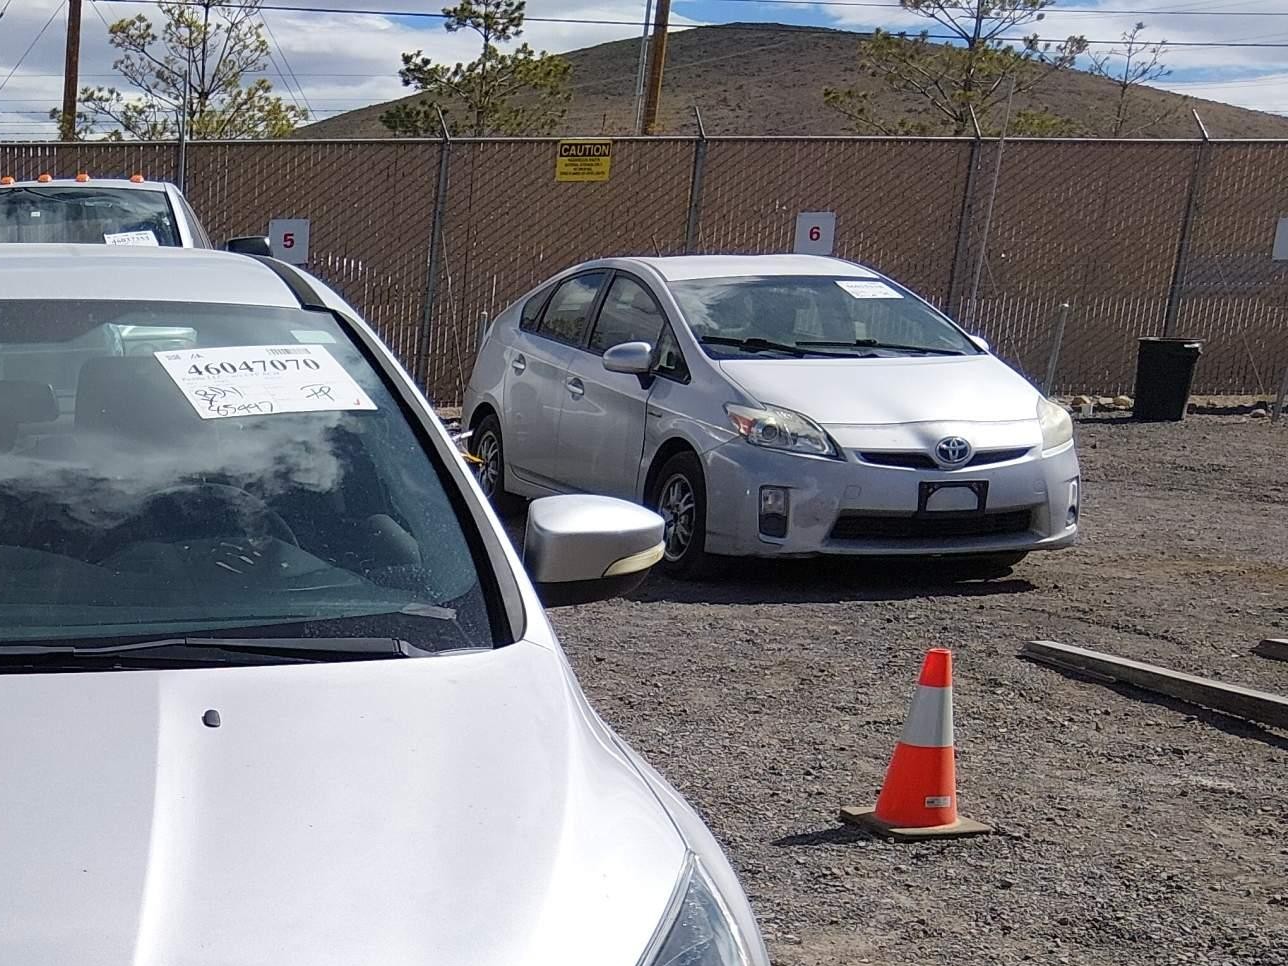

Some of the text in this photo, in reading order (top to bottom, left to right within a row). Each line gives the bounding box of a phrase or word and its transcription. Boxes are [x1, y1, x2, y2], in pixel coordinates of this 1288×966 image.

[561, 144, 610, 156] CAUTION
[283, 233, 295, 248] 5
[809, 226, 820, 241] 6
[187, 358, 320, 376] 46047070
